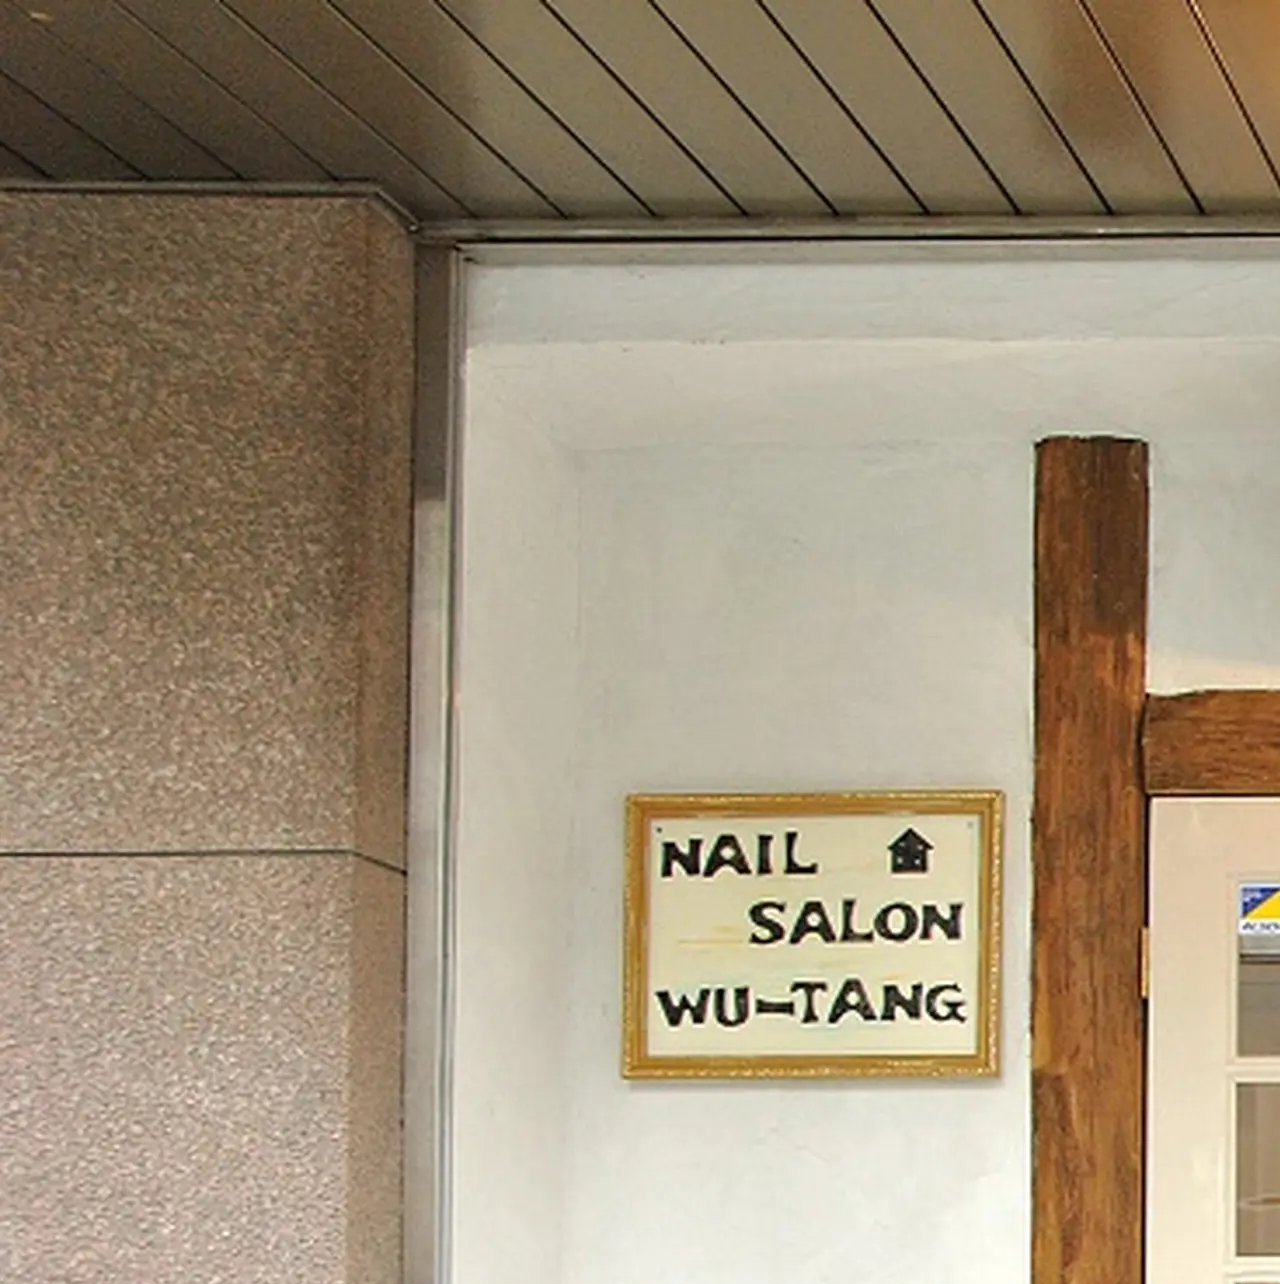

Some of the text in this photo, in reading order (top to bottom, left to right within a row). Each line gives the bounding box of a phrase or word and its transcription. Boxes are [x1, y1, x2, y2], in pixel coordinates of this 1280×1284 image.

[660, 831, 818, 878] NAIL
[748, 899, 963, 945] SALON
[655, 978, 967, 1027] WU-TANG
